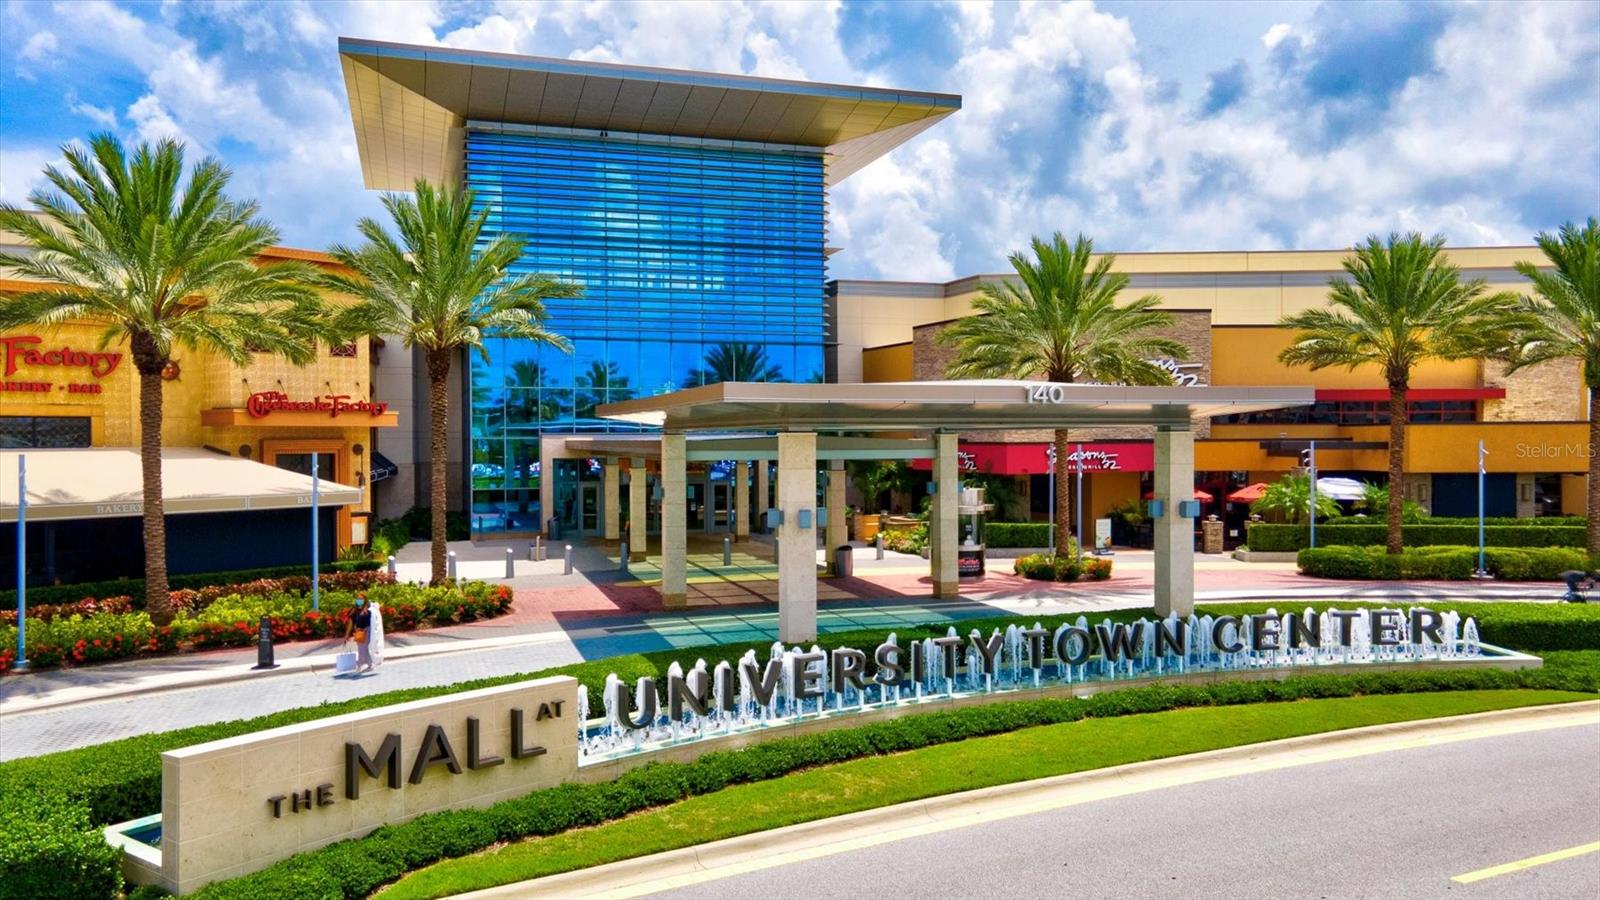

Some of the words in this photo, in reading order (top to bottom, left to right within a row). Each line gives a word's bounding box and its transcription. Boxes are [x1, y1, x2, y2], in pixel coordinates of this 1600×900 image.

[0, 336, 122, 378] Factory
[68, 383, 102, 393] BAR
[1024, 384, 1064, 404] 140
[325, 395, 388, 417] Factory
[615, 632, 1003, 731] UNIVERSITY
[1021, 620, 1186, 669] TOWN
[1212, 608, 1444, 654] CENTER
[267, 782, 335, 819] THE
[345, 707, 547, 801] MALL
[536, 699, 566, 722] AT
